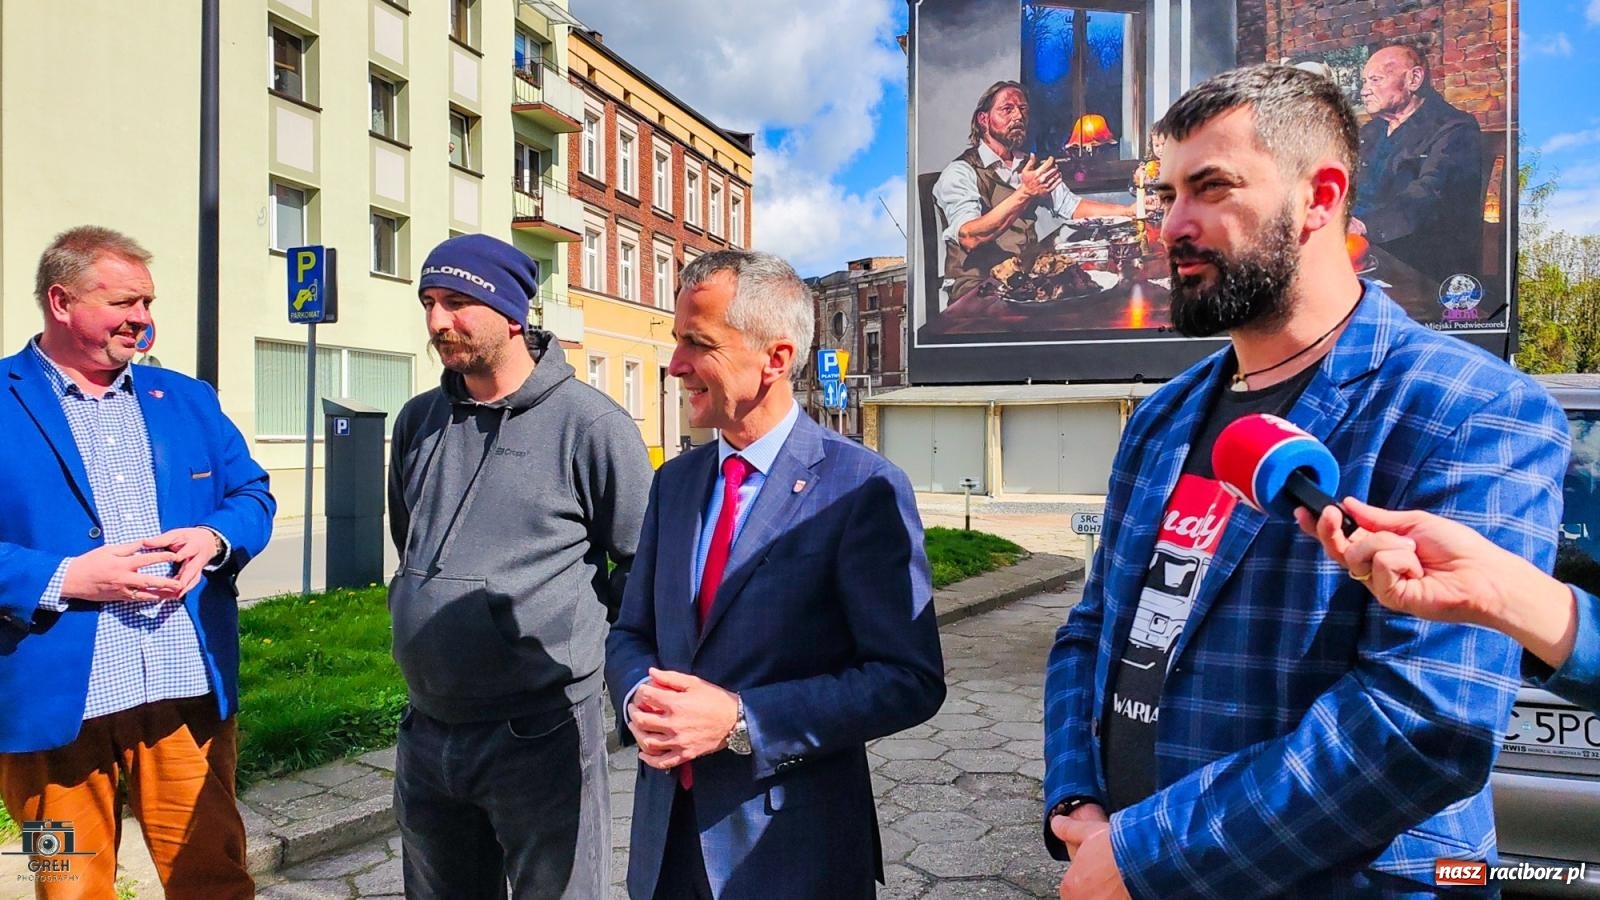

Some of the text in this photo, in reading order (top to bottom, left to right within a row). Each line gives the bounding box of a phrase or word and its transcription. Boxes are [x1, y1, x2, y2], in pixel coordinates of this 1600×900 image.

[297, 251, 316, 283] P
[290, 311, 320, 319] PARKOMAT
[1454, 320, 1505, 329] Podwieczorek
[824, 353, 838, 372] P
[337, 420, 348, 434] P
[1080, 515, 1099, 523] SRC
